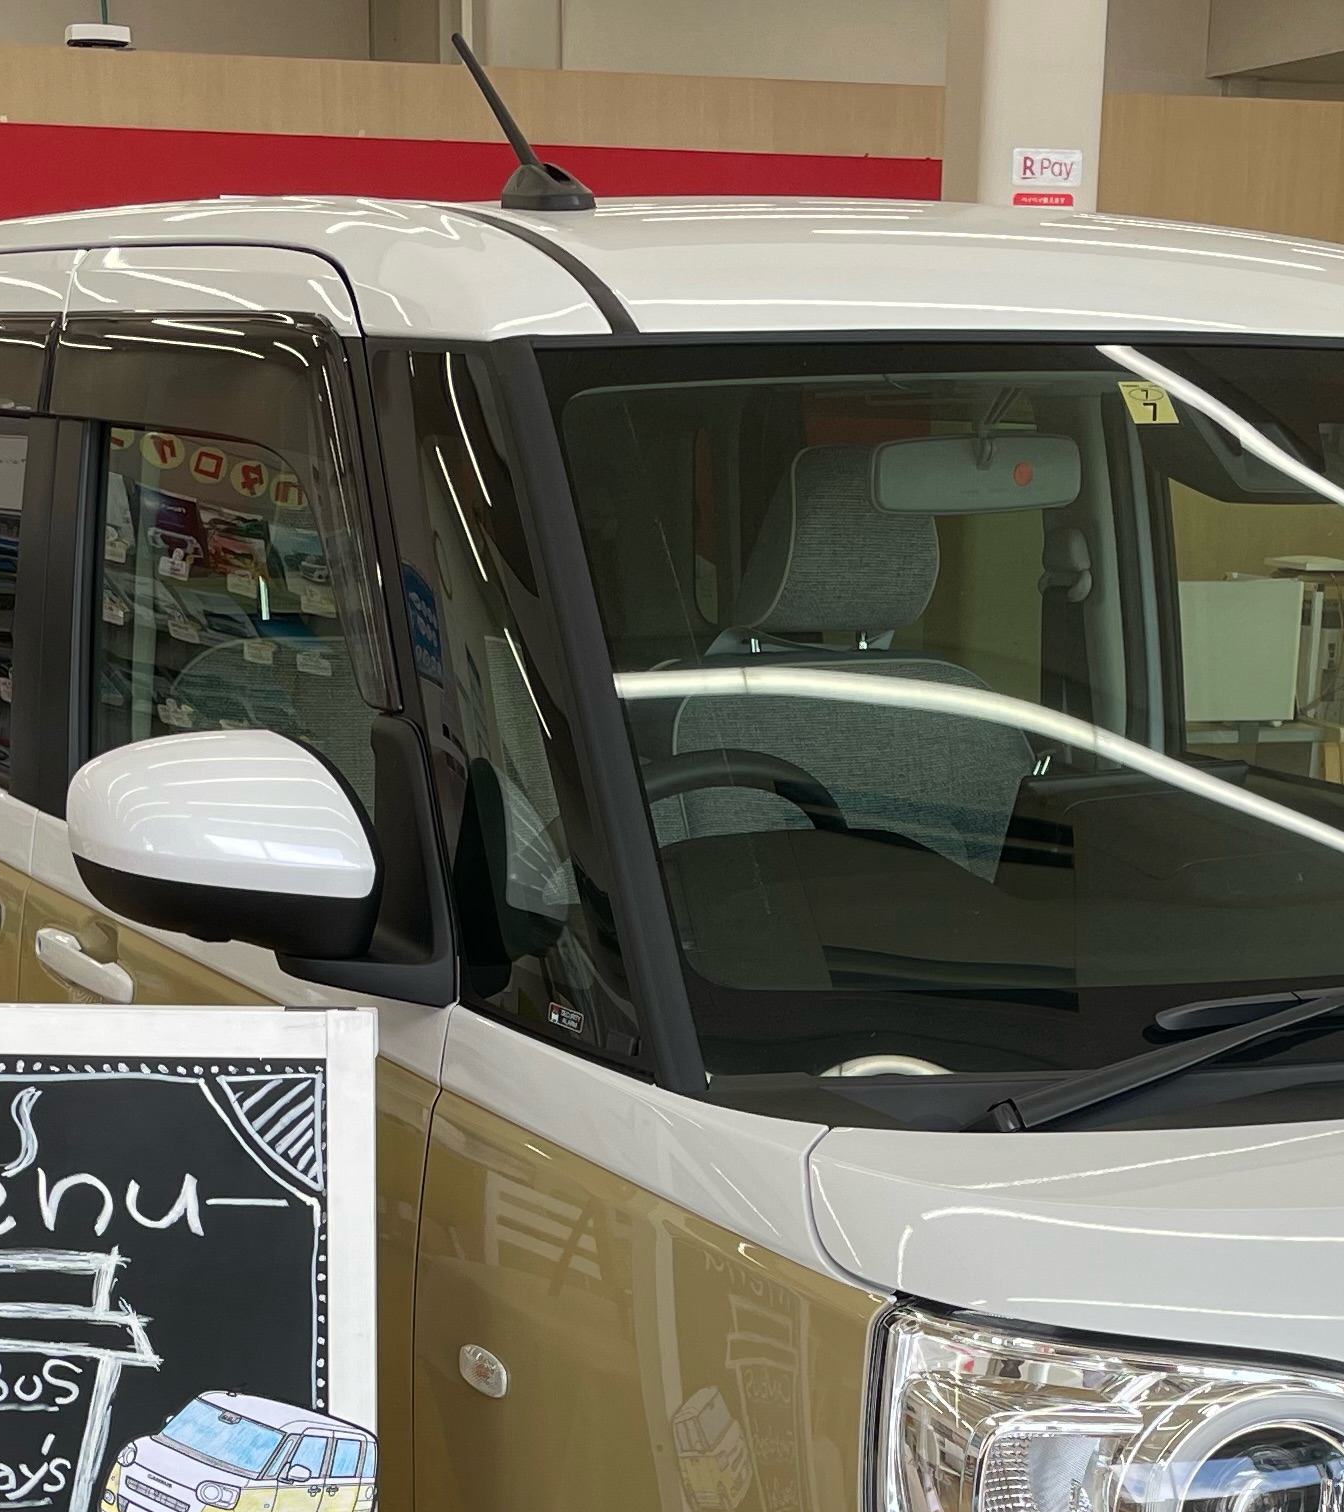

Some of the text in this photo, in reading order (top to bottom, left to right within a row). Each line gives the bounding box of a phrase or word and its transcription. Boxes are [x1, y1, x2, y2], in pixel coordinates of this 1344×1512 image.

[1040, 158, 1073, 180] Pay
[1141, 389, 1148, 400] 7
[1143, 403, 1157, 421] 7
